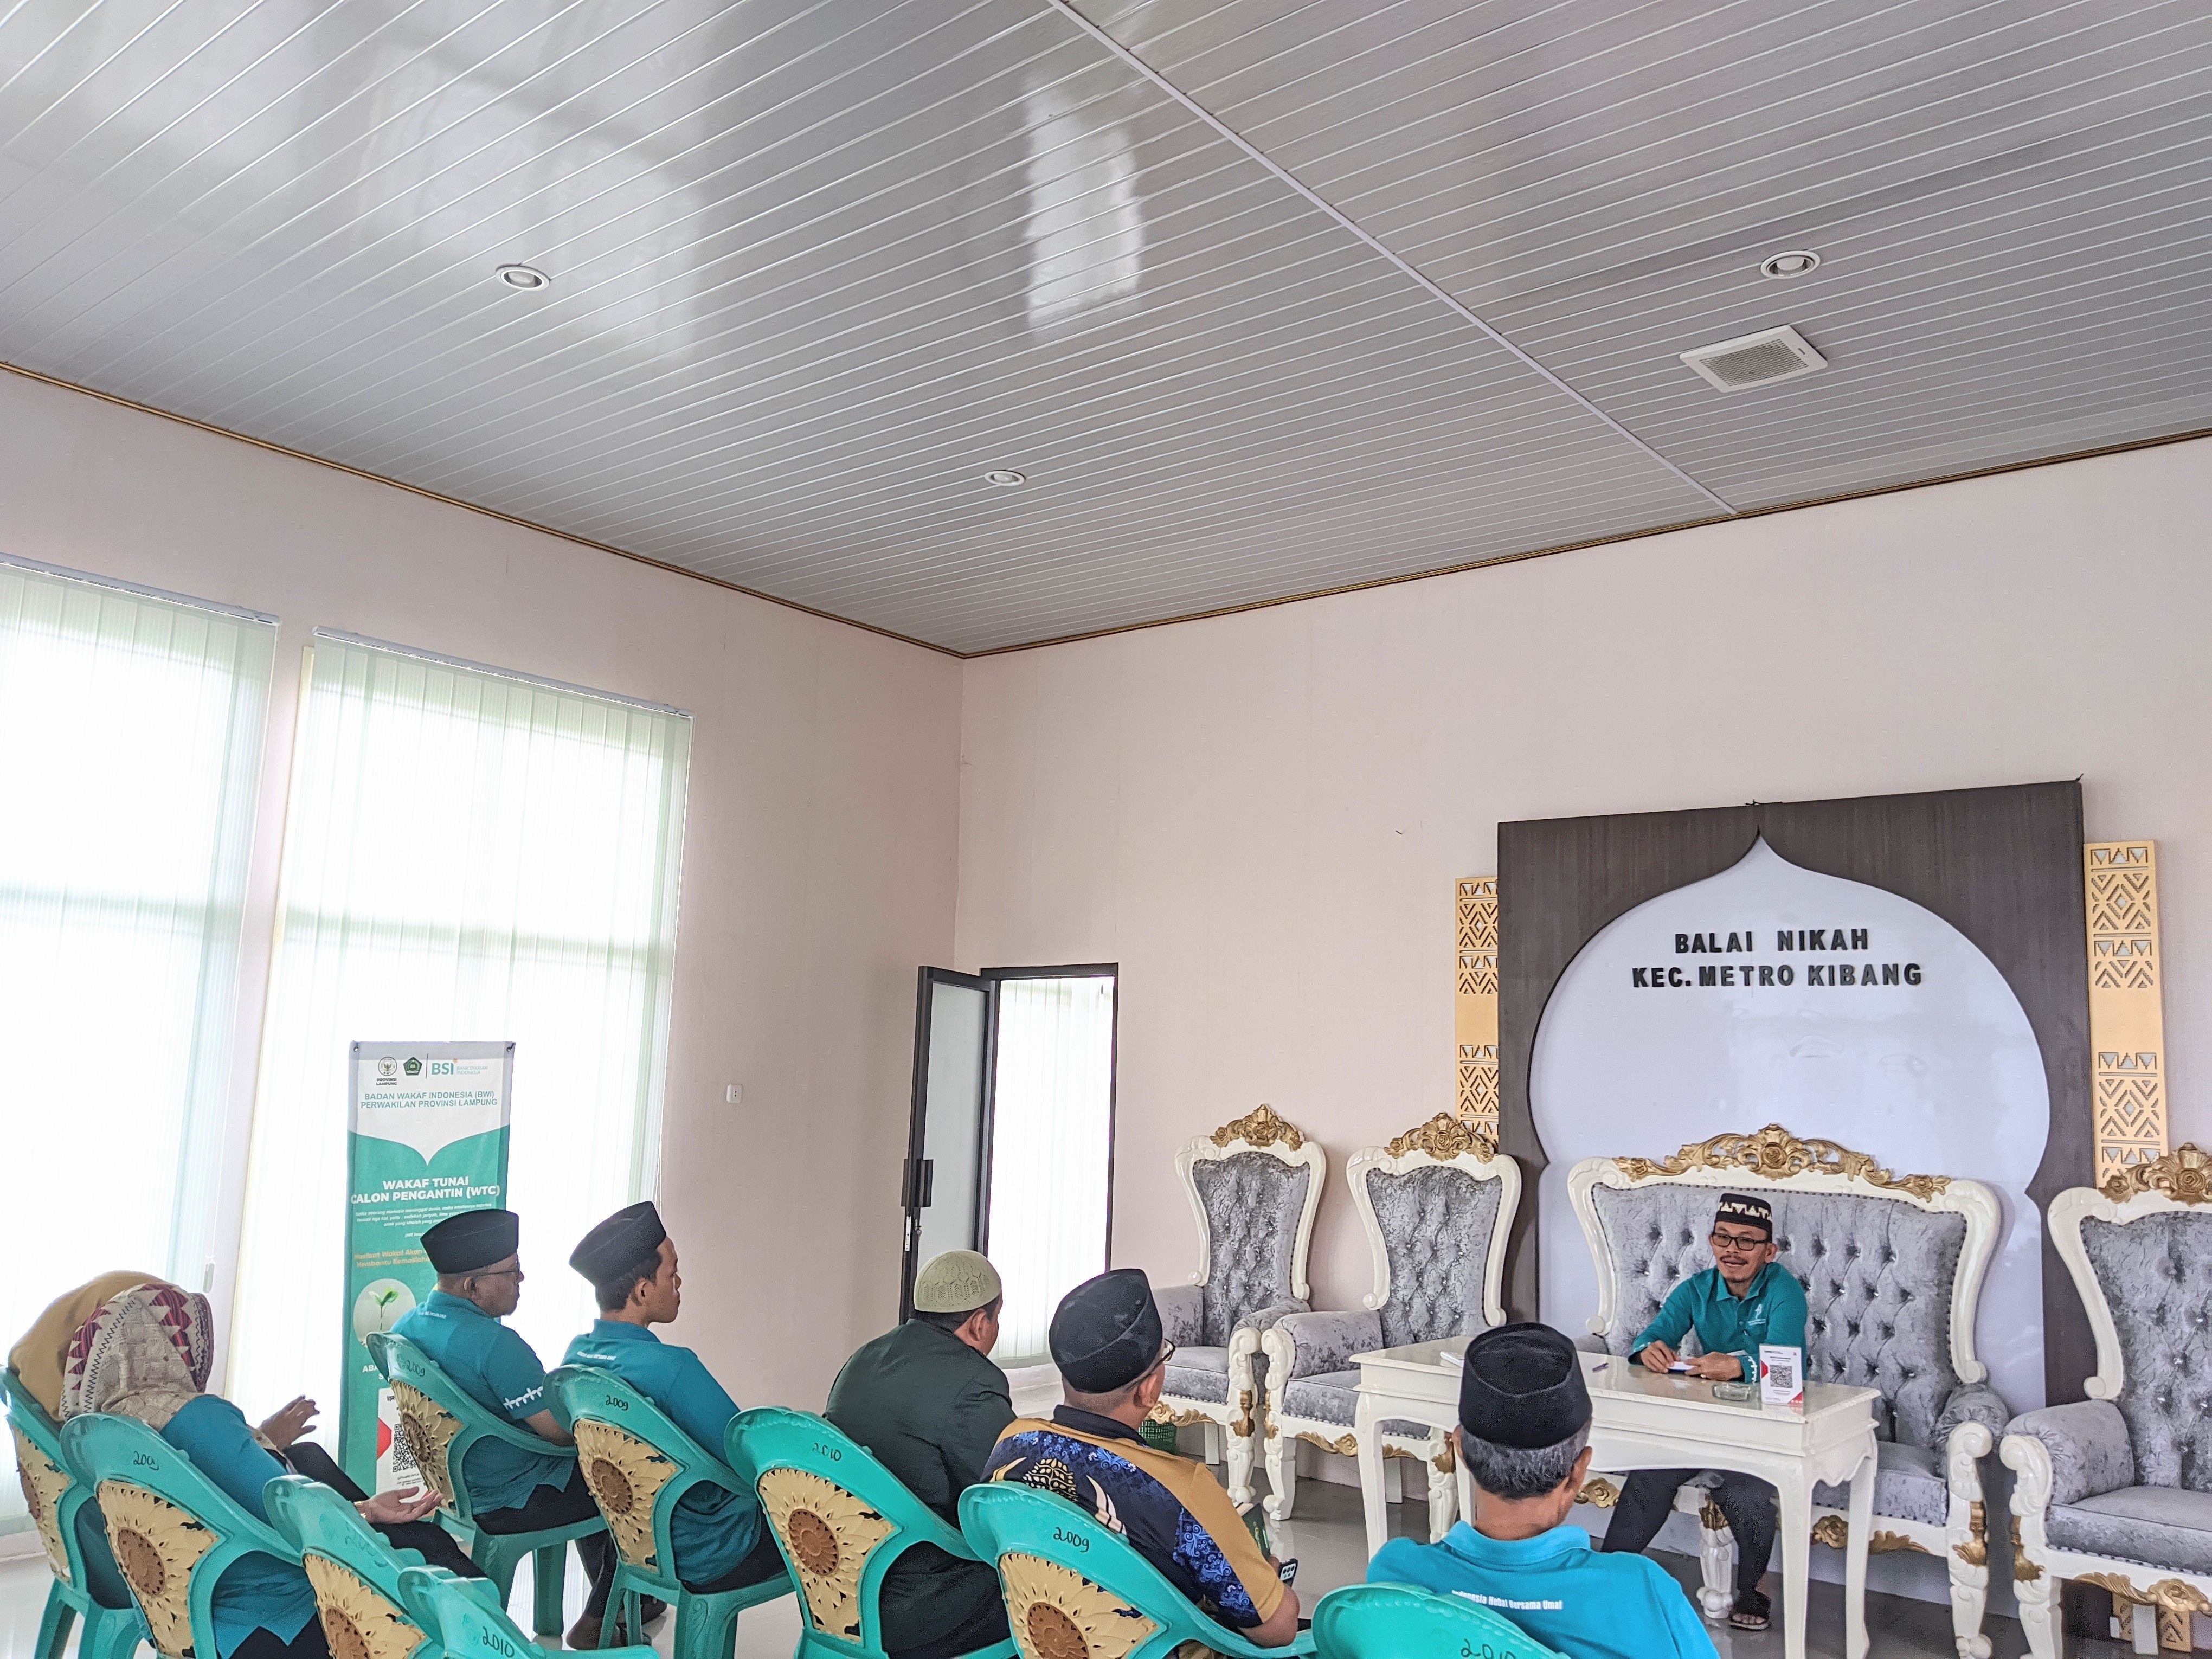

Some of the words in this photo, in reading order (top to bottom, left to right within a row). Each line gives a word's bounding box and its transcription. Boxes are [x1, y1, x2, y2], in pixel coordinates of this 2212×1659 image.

[1675, 931, 1753, 953] BALAI
[1777, 928, 1868, 951] NIKAH
[1808, 963, 1922, 986] KIBANG
[431, 1062, 454, 1075] BSI
[474, 1090, 495, 1099] (BWI)
[361, 1101, 416, 1109] PERWAKILAN
[419, 1099, 457, 1108] PROVINSI
[459, 1098, 498, 1107] LAMPUNG
[382, 1178, 429, 1190] WAKAF
[432, 1176, 469, 1187] TUNAI
[350, 1192, 389, 1204] CALON
[392, 1188, 464, 1201] PENGANTIN
[466, 1185, 500, 1199] (WTC)
[605, 1394, 629, 1411] 2009
[1053, 1526, 1090, 1553] 2009
[1508, 1600, 1541, 1610] Bersama
[1542, 1600, 1563, 1610] Umat
[482, 1626, 515, 1658] 2010
